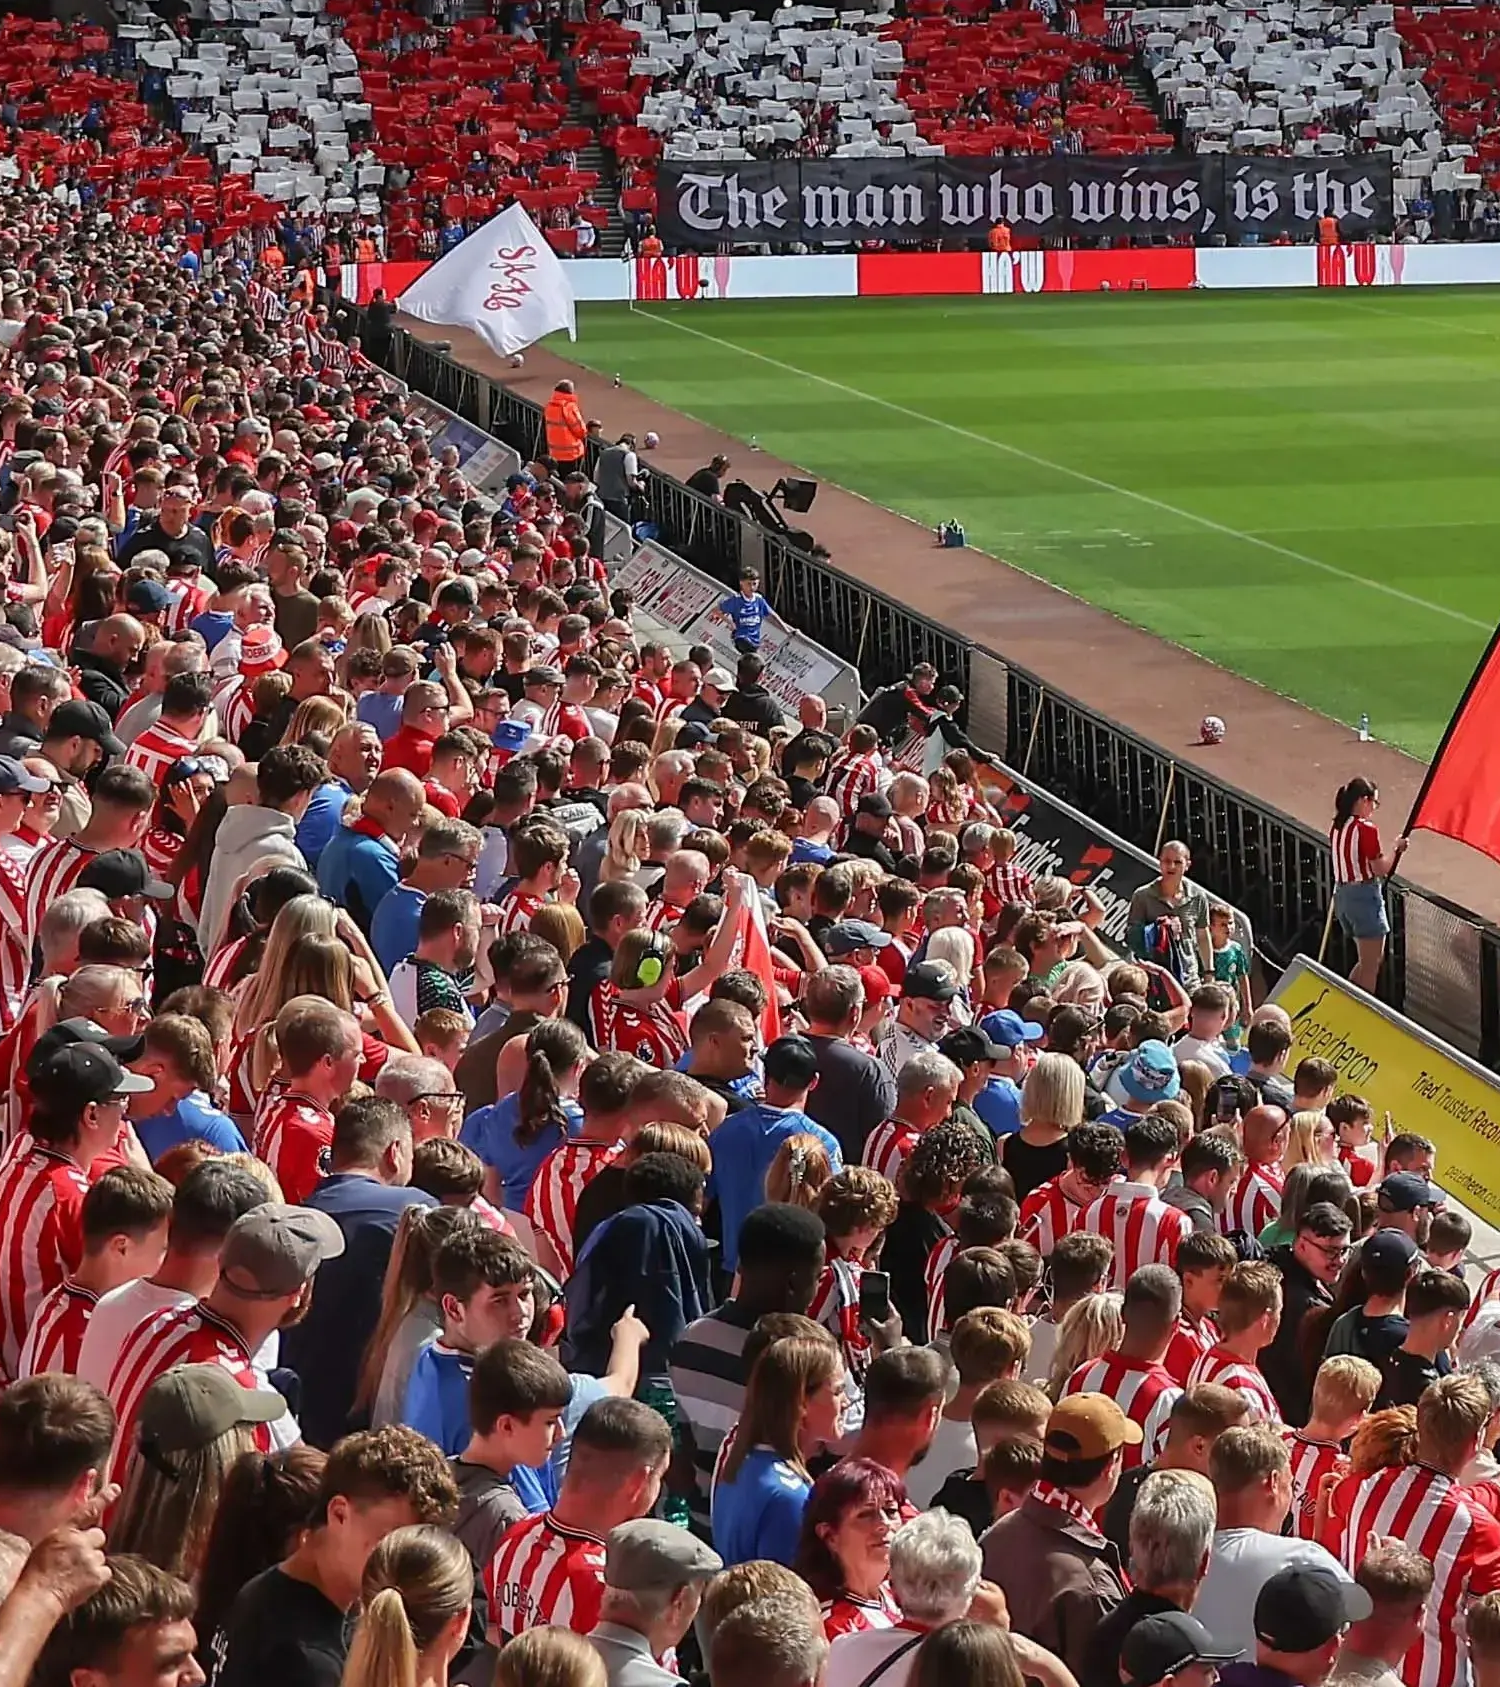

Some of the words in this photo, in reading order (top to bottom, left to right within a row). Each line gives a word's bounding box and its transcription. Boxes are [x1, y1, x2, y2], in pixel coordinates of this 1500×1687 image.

[675, 172, 788, 230] The
[801, 183, 926, 229] man
[939, 168, 1054, 226] who
[1070, 169, 1216, 234] wins,
[1232, 167, 1281, 221] is
[1291, 169, 1376, 219] the
[1411, 1070, 1441, 1101] Tried
[1434, 1085, 1477, 1130] Trusted
